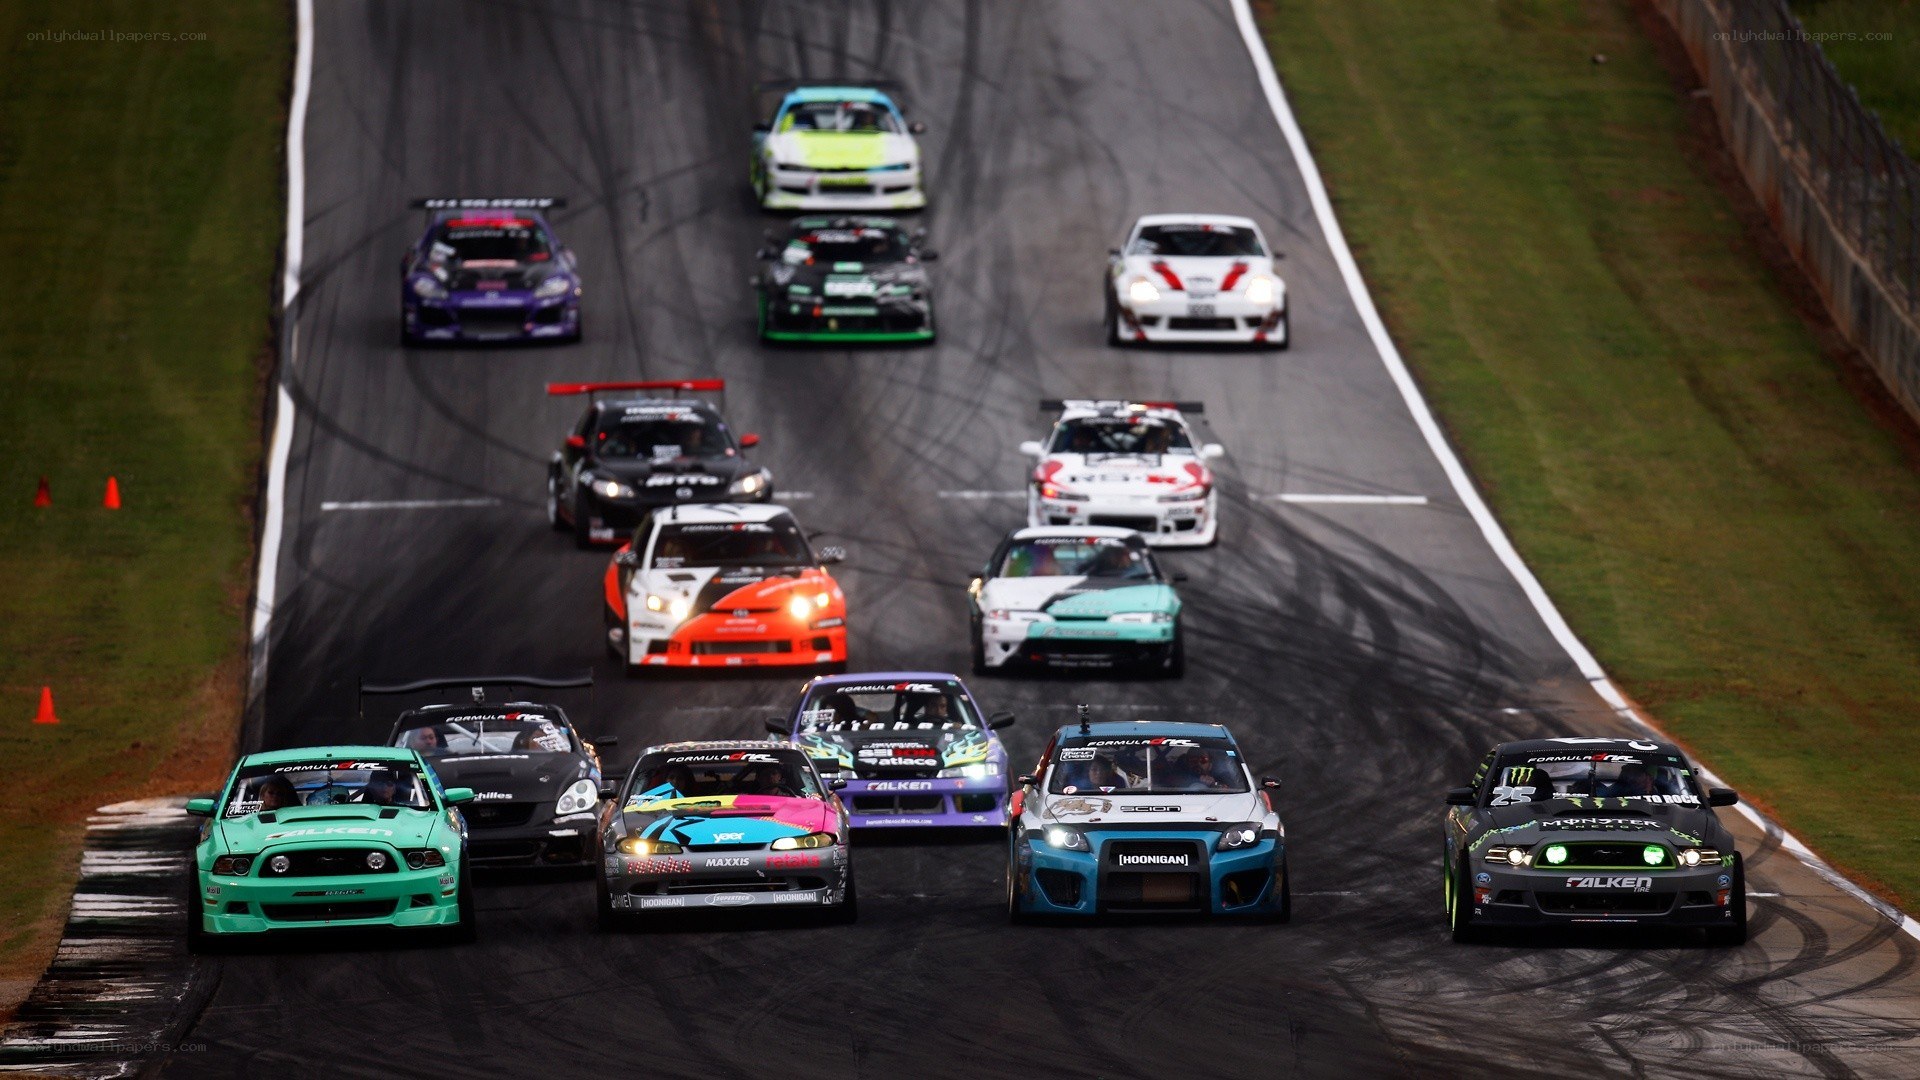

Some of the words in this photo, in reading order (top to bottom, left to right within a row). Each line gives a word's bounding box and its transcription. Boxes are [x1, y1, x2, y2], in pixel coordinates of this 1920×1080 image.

[867, 782, 932, 790] FALKEN
[1490, 786, 1536, 806] 25
[1643, 795, 1662, 803] TO
[1662, 795, 1701, 804] ROCK
[1542, 818, 1660, 828] MONSTER
[265, 827, 393, 841] FALKEN
[706, 857, 750, 867] MAXXIS
[765, 852, 820, 868] retaks
[1566, 877, 1652, 888] FALKEN
